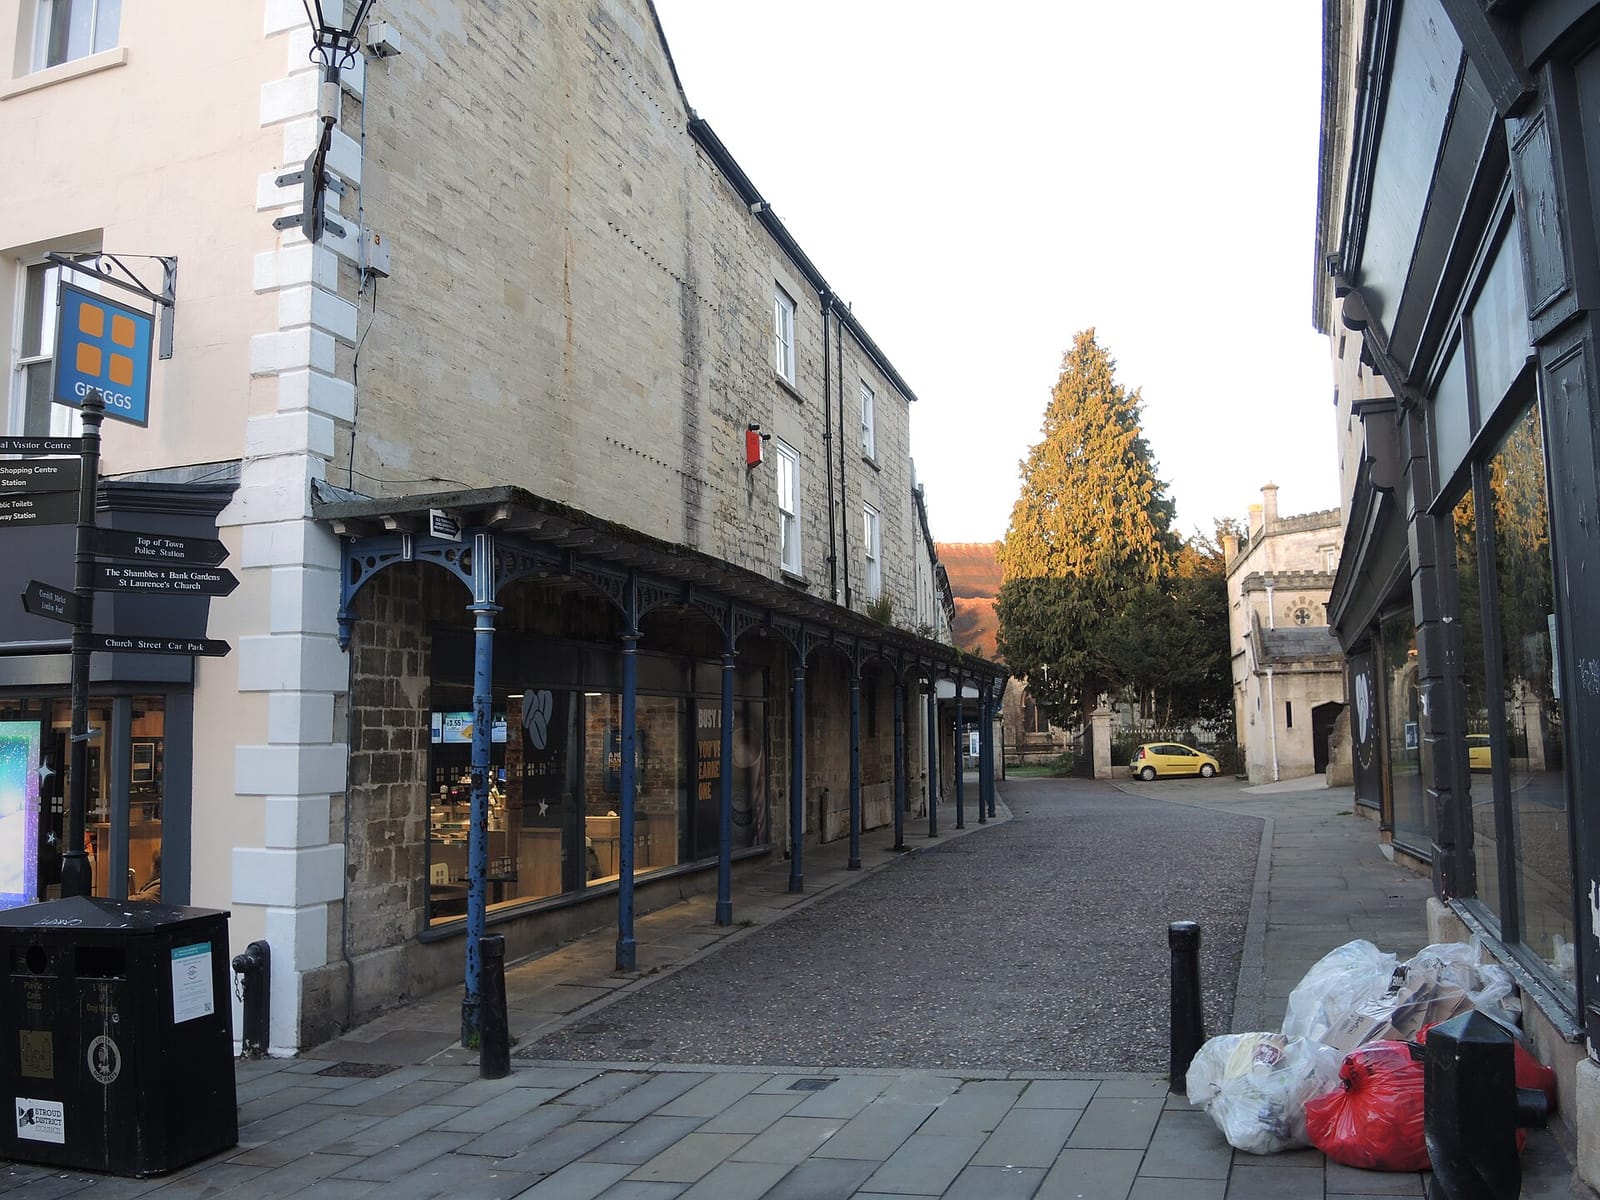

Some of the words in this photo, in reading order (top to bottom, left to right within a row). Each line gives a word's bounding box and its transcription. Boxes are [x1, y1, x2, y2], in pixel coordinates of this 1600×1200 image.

[13, 441, 40, 449] Visitor
[44, 441, 72, 449] Centre
[0, 467, 33, 475] Shopping
[12, 500, 34, 508] Toilets
[13, 512, 37, 520] Station
[137, 537, 151, 546] Top
[165, 540, 184, 548] Town
[134, 547, 156, 555] Police
[160, 548, 185, 558] Station
[105, 568, 121, 576] The
[123, 569, 159, 578] Shambles
[169, 572, 189, 580] Bank
[190, 573, 220, 581] Gardens
[118, 579, 127, 587] St
[130, 579, 170, 588] Laurence's
[174, 581, 201, 590] Church
[105, 639, 133, 647] Church
[138, 640, 161, 649] Street
[187, 643, 205, 651] Park
[35, 1108, 62, 1118] STROUD
[35, 1117, 62, 1126] DISTRICT
